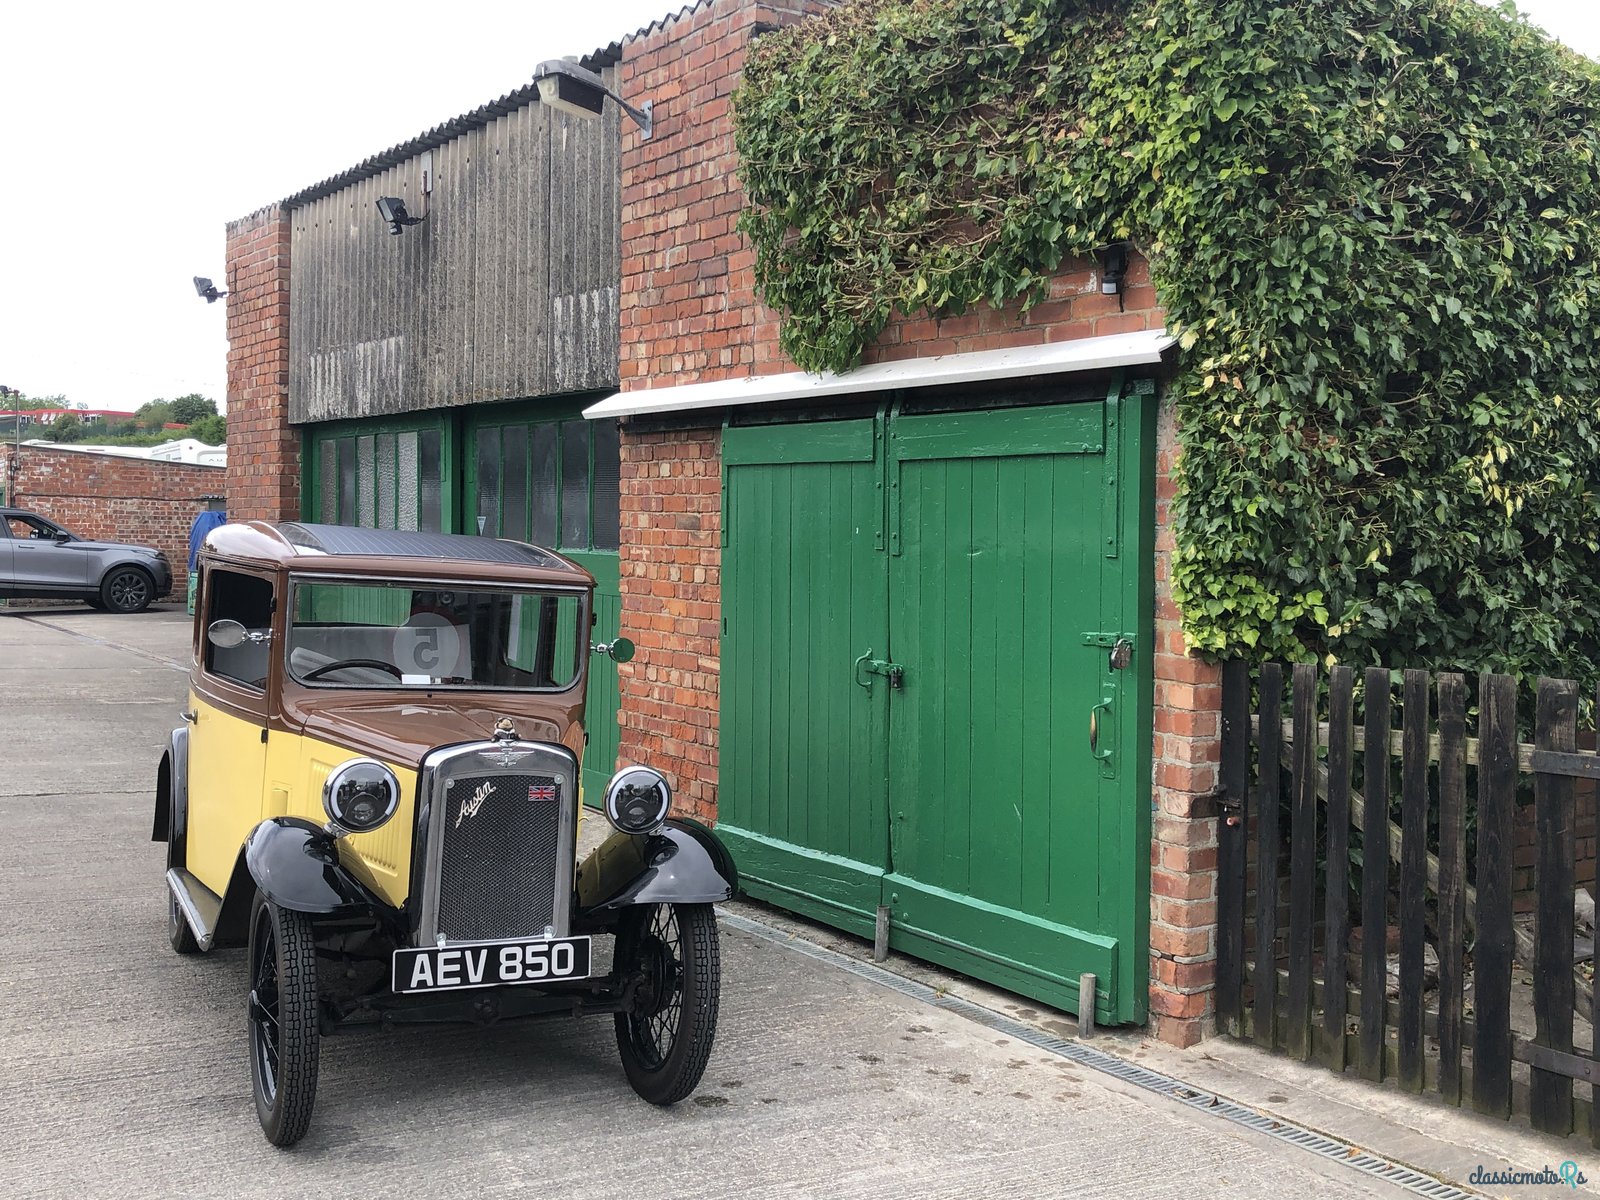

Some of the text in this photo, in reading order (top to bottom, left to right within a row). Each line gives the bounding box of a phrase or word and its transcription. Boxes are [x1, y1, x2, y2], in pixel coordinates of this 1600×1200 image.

[455, 781, 497, 829] Austin
[410, 942, 575, 988] AEV 850
